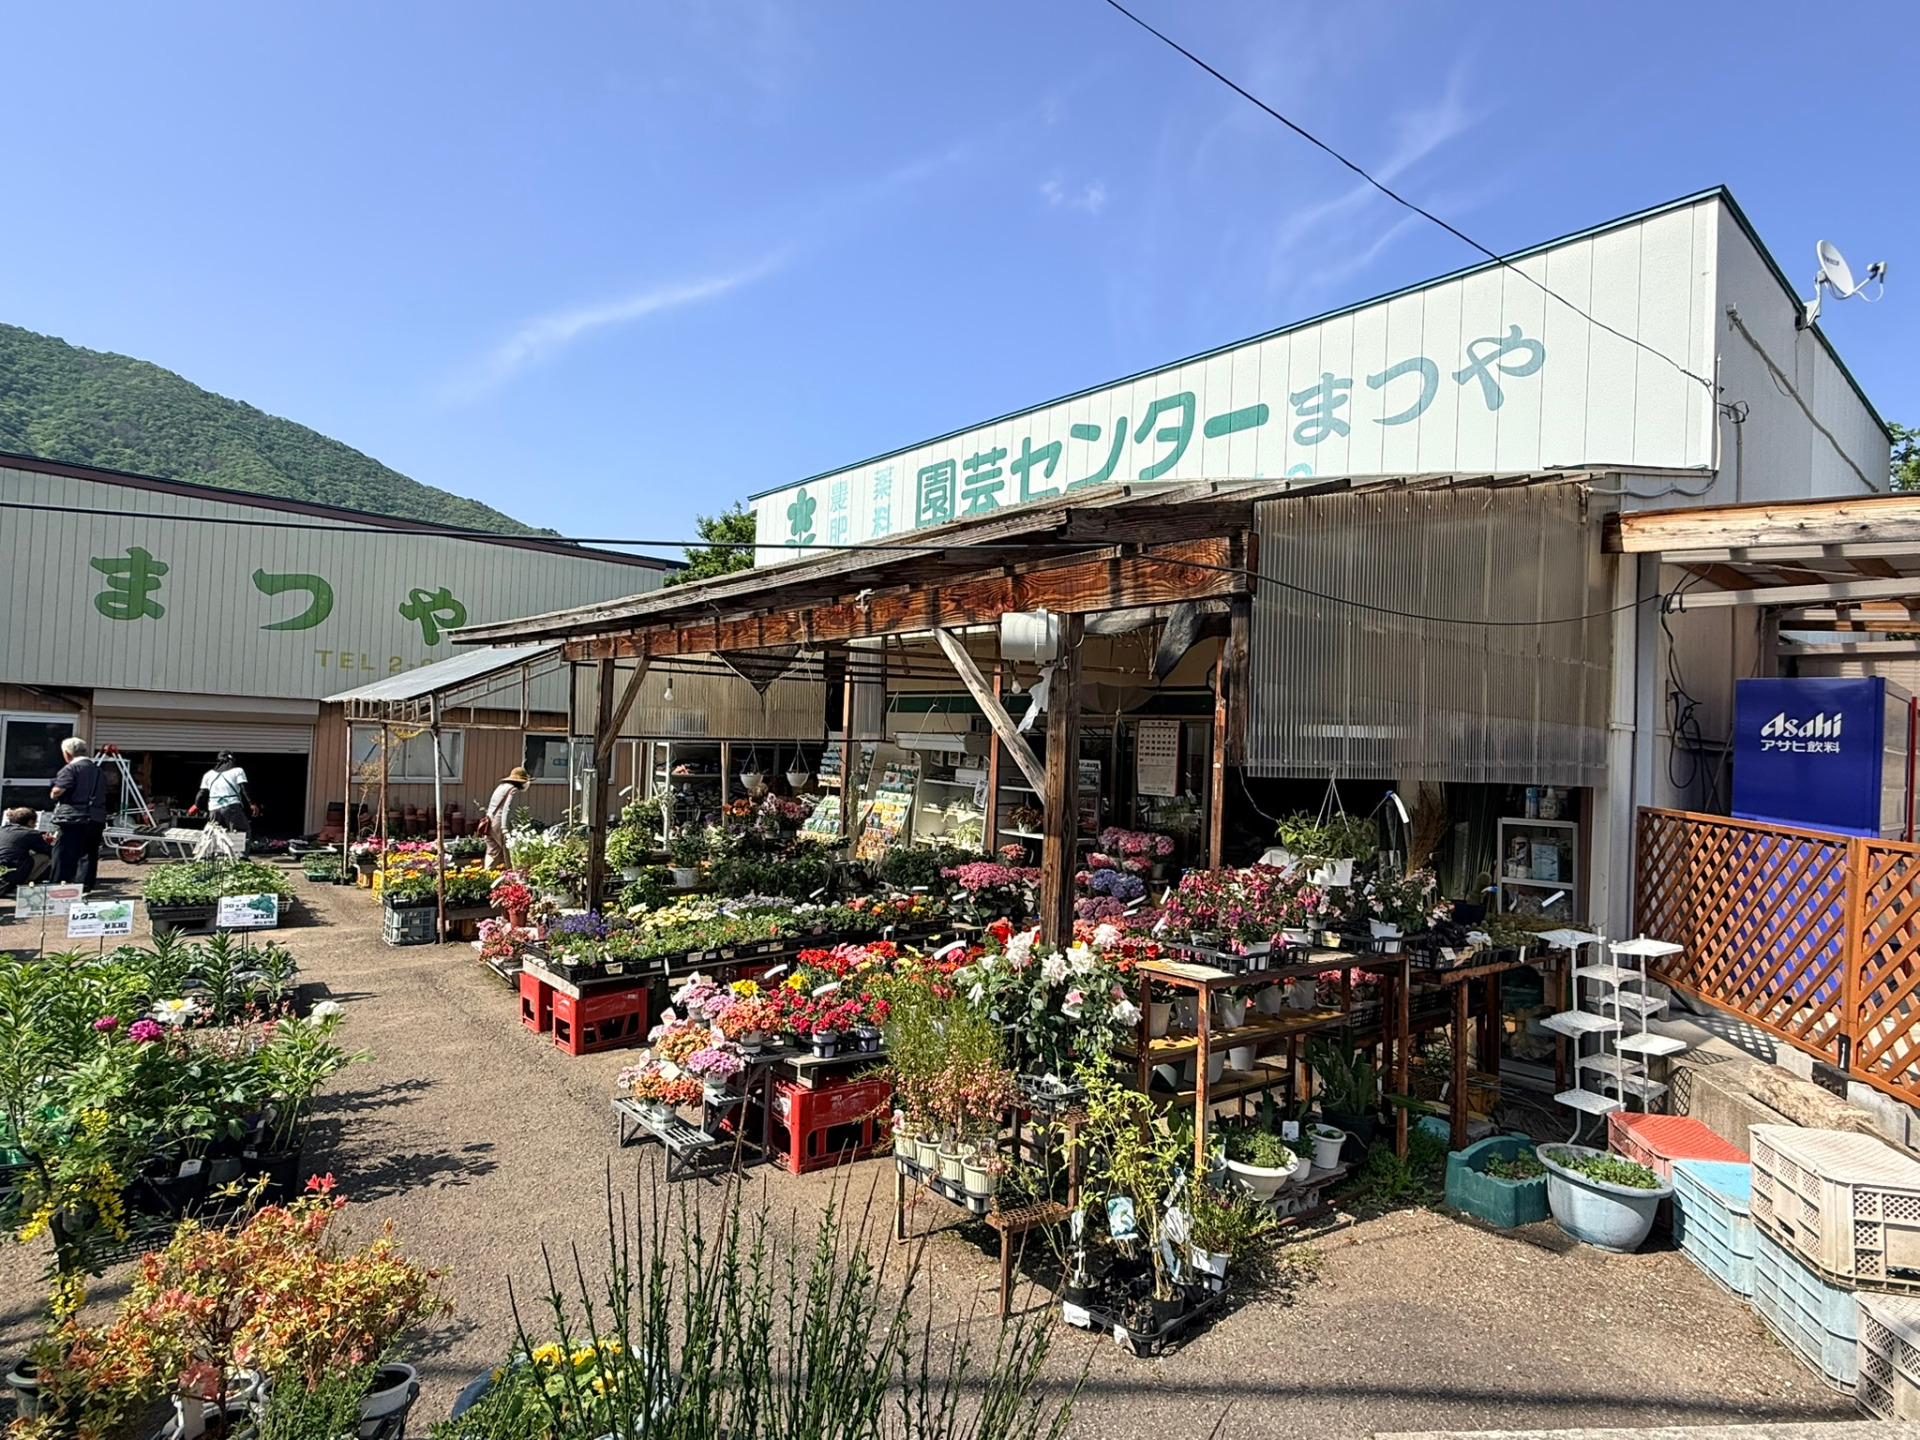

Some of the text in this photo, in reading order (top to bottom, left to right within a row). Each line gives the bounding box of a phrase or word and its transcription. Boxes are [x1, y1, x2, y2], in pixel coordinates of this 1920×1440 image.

[1290, 324, 1546, 446] まつや
[90, 547, 467, 646] まつや
[314, 649, 375, 671] TEL
[1760, 711, 1842, 738] Asahi
[1760, 739, 1841, 754] アサヒ飲料
[71, 912, 97, 920] レタス
